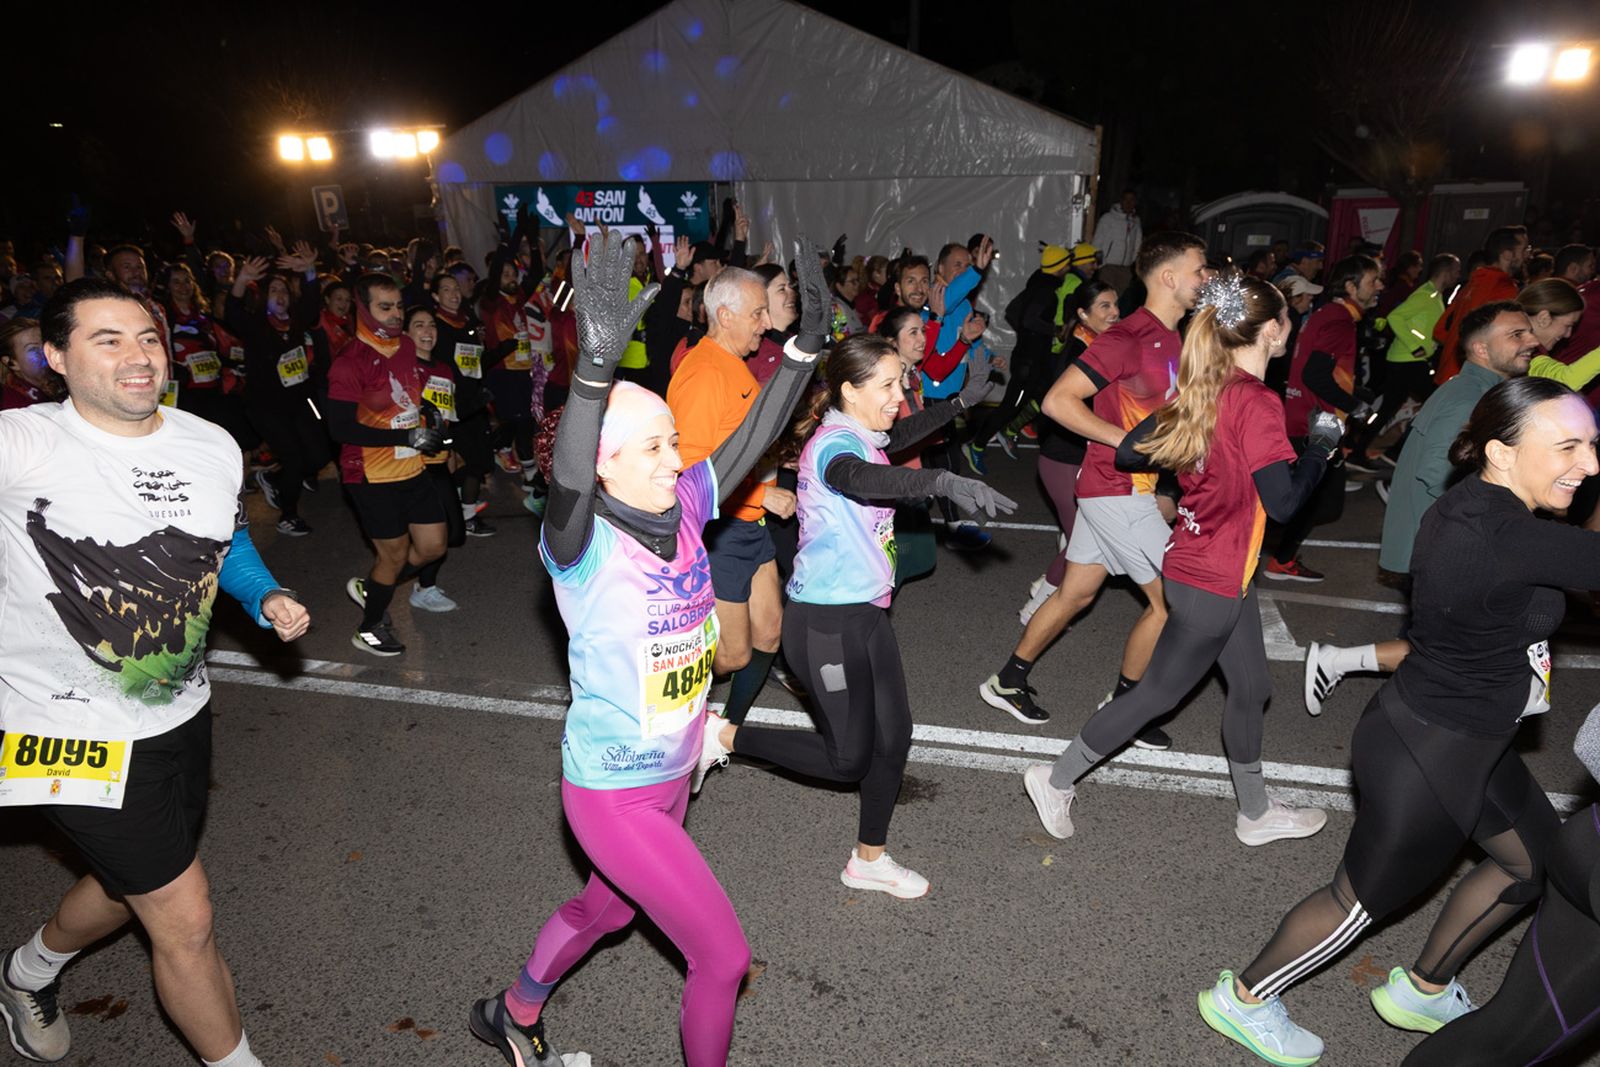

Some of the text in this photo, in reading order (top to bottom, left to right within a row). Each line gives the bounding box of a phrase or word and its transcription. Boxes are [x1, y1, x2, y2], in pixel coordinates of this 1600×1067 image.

[575, 190, 626, 206] 43 SAN
[320, 191, 338, 226] P
[574, 203, 625, 222] ANTÓN
[647, 603, 681, 617] CLUB
[665, 642, 694, 655] NOCH
[653, 656, 675, 672] SAN
[662, 649, 712, 700] 4849
[15, 734, 108, 768] 8095
[46, 768, 71, 777] David
[623, 763, 635, 771] del
